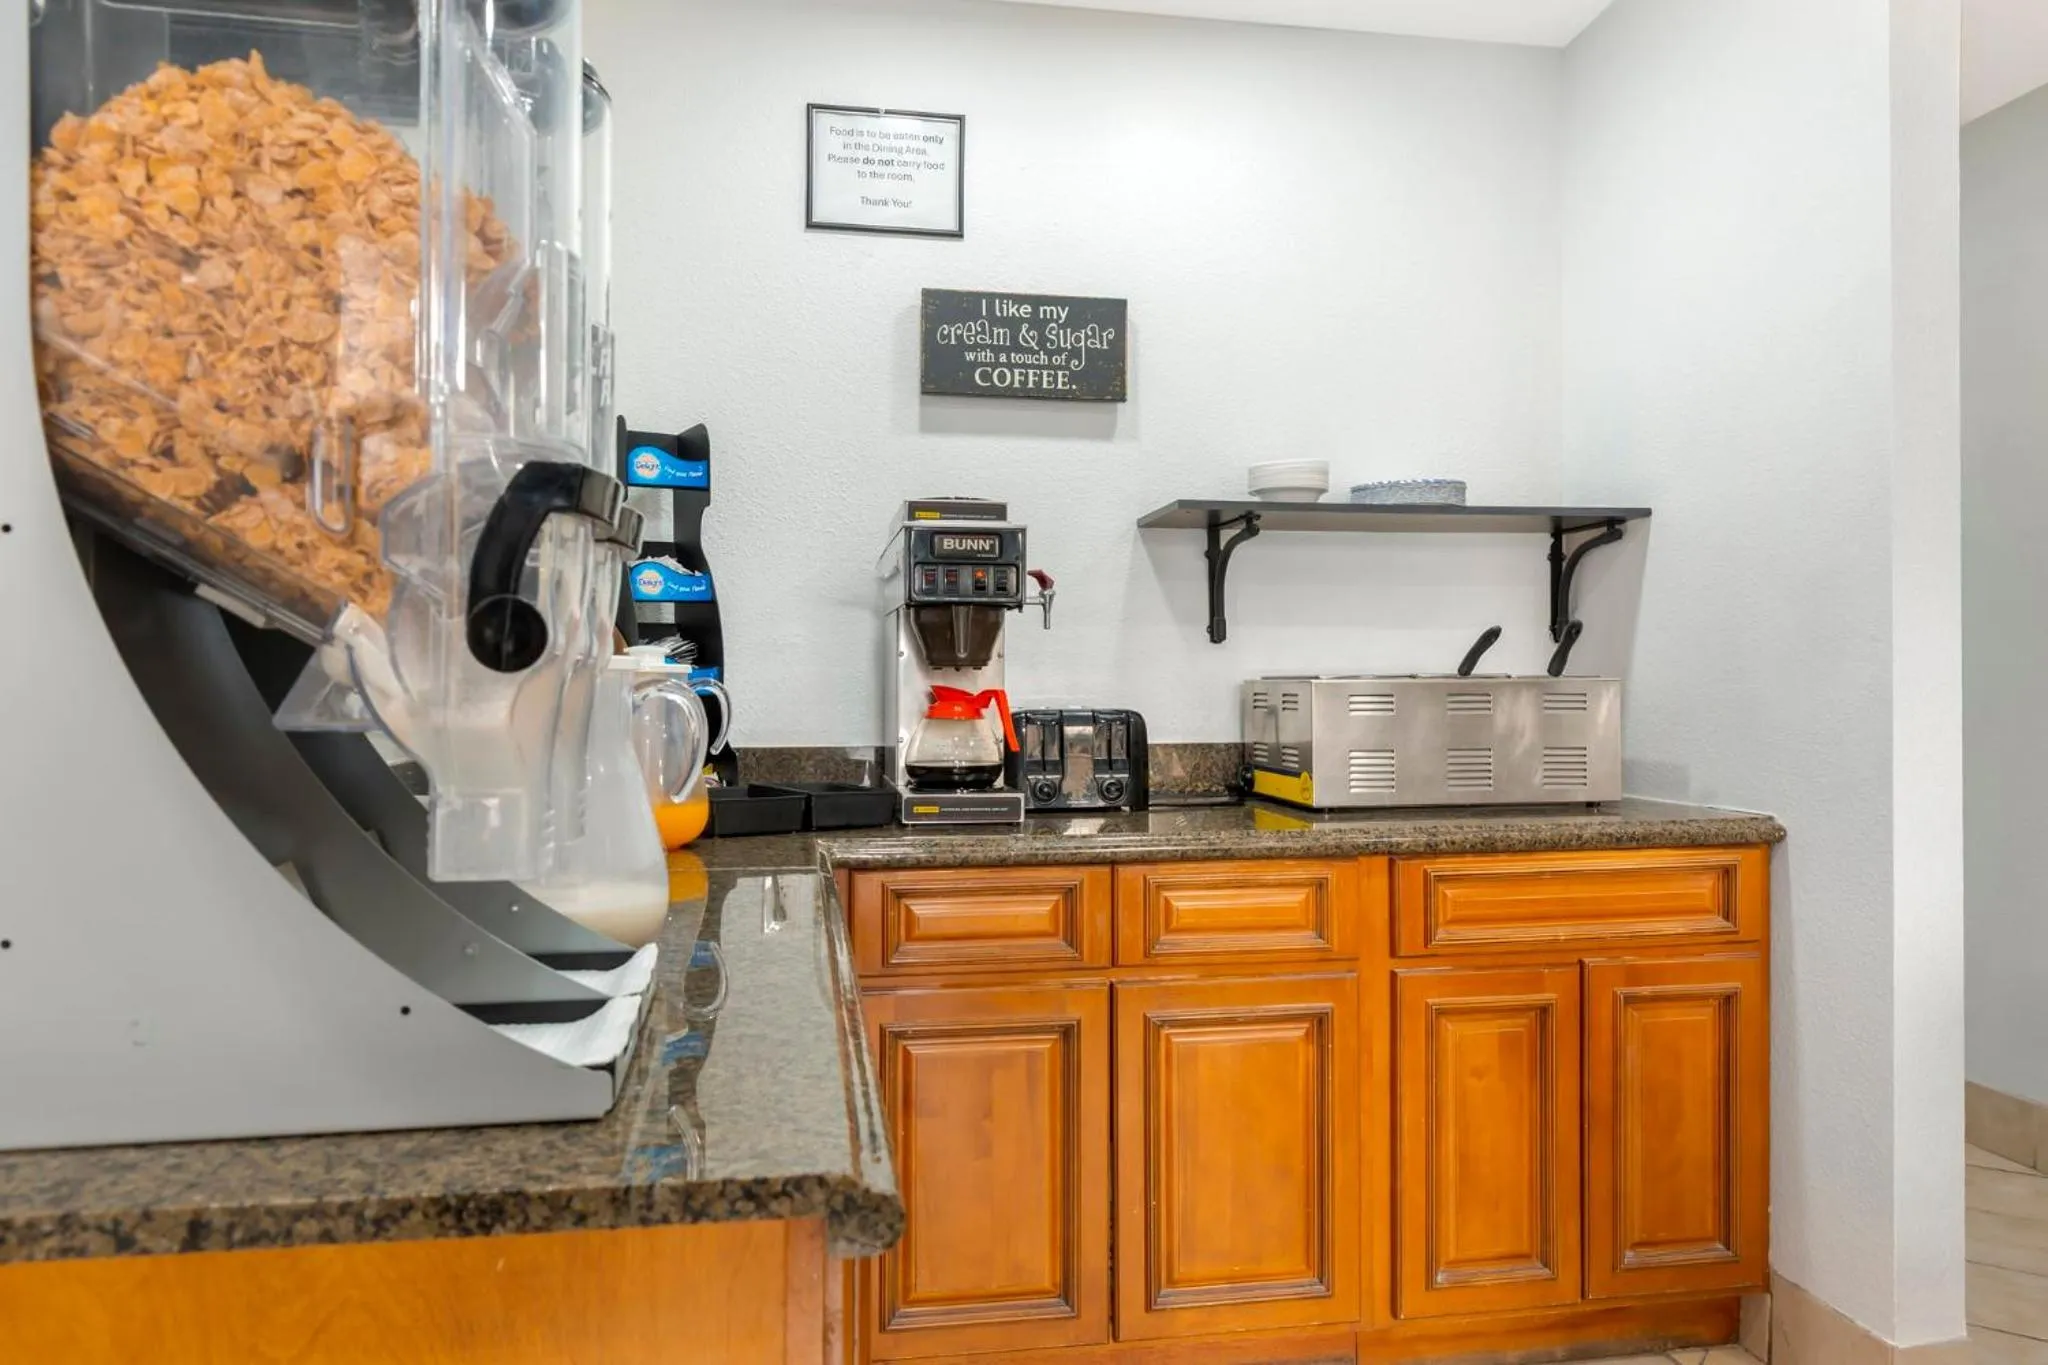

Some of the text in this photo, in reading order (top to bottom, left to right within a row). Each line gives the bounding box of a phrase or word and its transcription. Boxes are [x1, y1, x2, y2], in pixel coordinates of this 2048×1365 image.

[829, 126, 944, 145] Food is to be eaten only
[843, 141, 852, 150] in
[854, 142, 870, 151] the
[872, 143, 904, 155] Dining
[828, 153, 945, 171] Please do not carry food
[857, 169, 867, 179] to
[869, 170, 885, 180] the
[860, 196, 888, 207] Thank
[981, 299, 1069, 323] I like my
[936, 319, 1010, 346] cream
[1019, 323, 1040, 350] &
[964, 349, 1069, 366] with a touch of
[974, 367, 1078, 390] COFFEE.
[942, 538, 991, 551] BUNN
